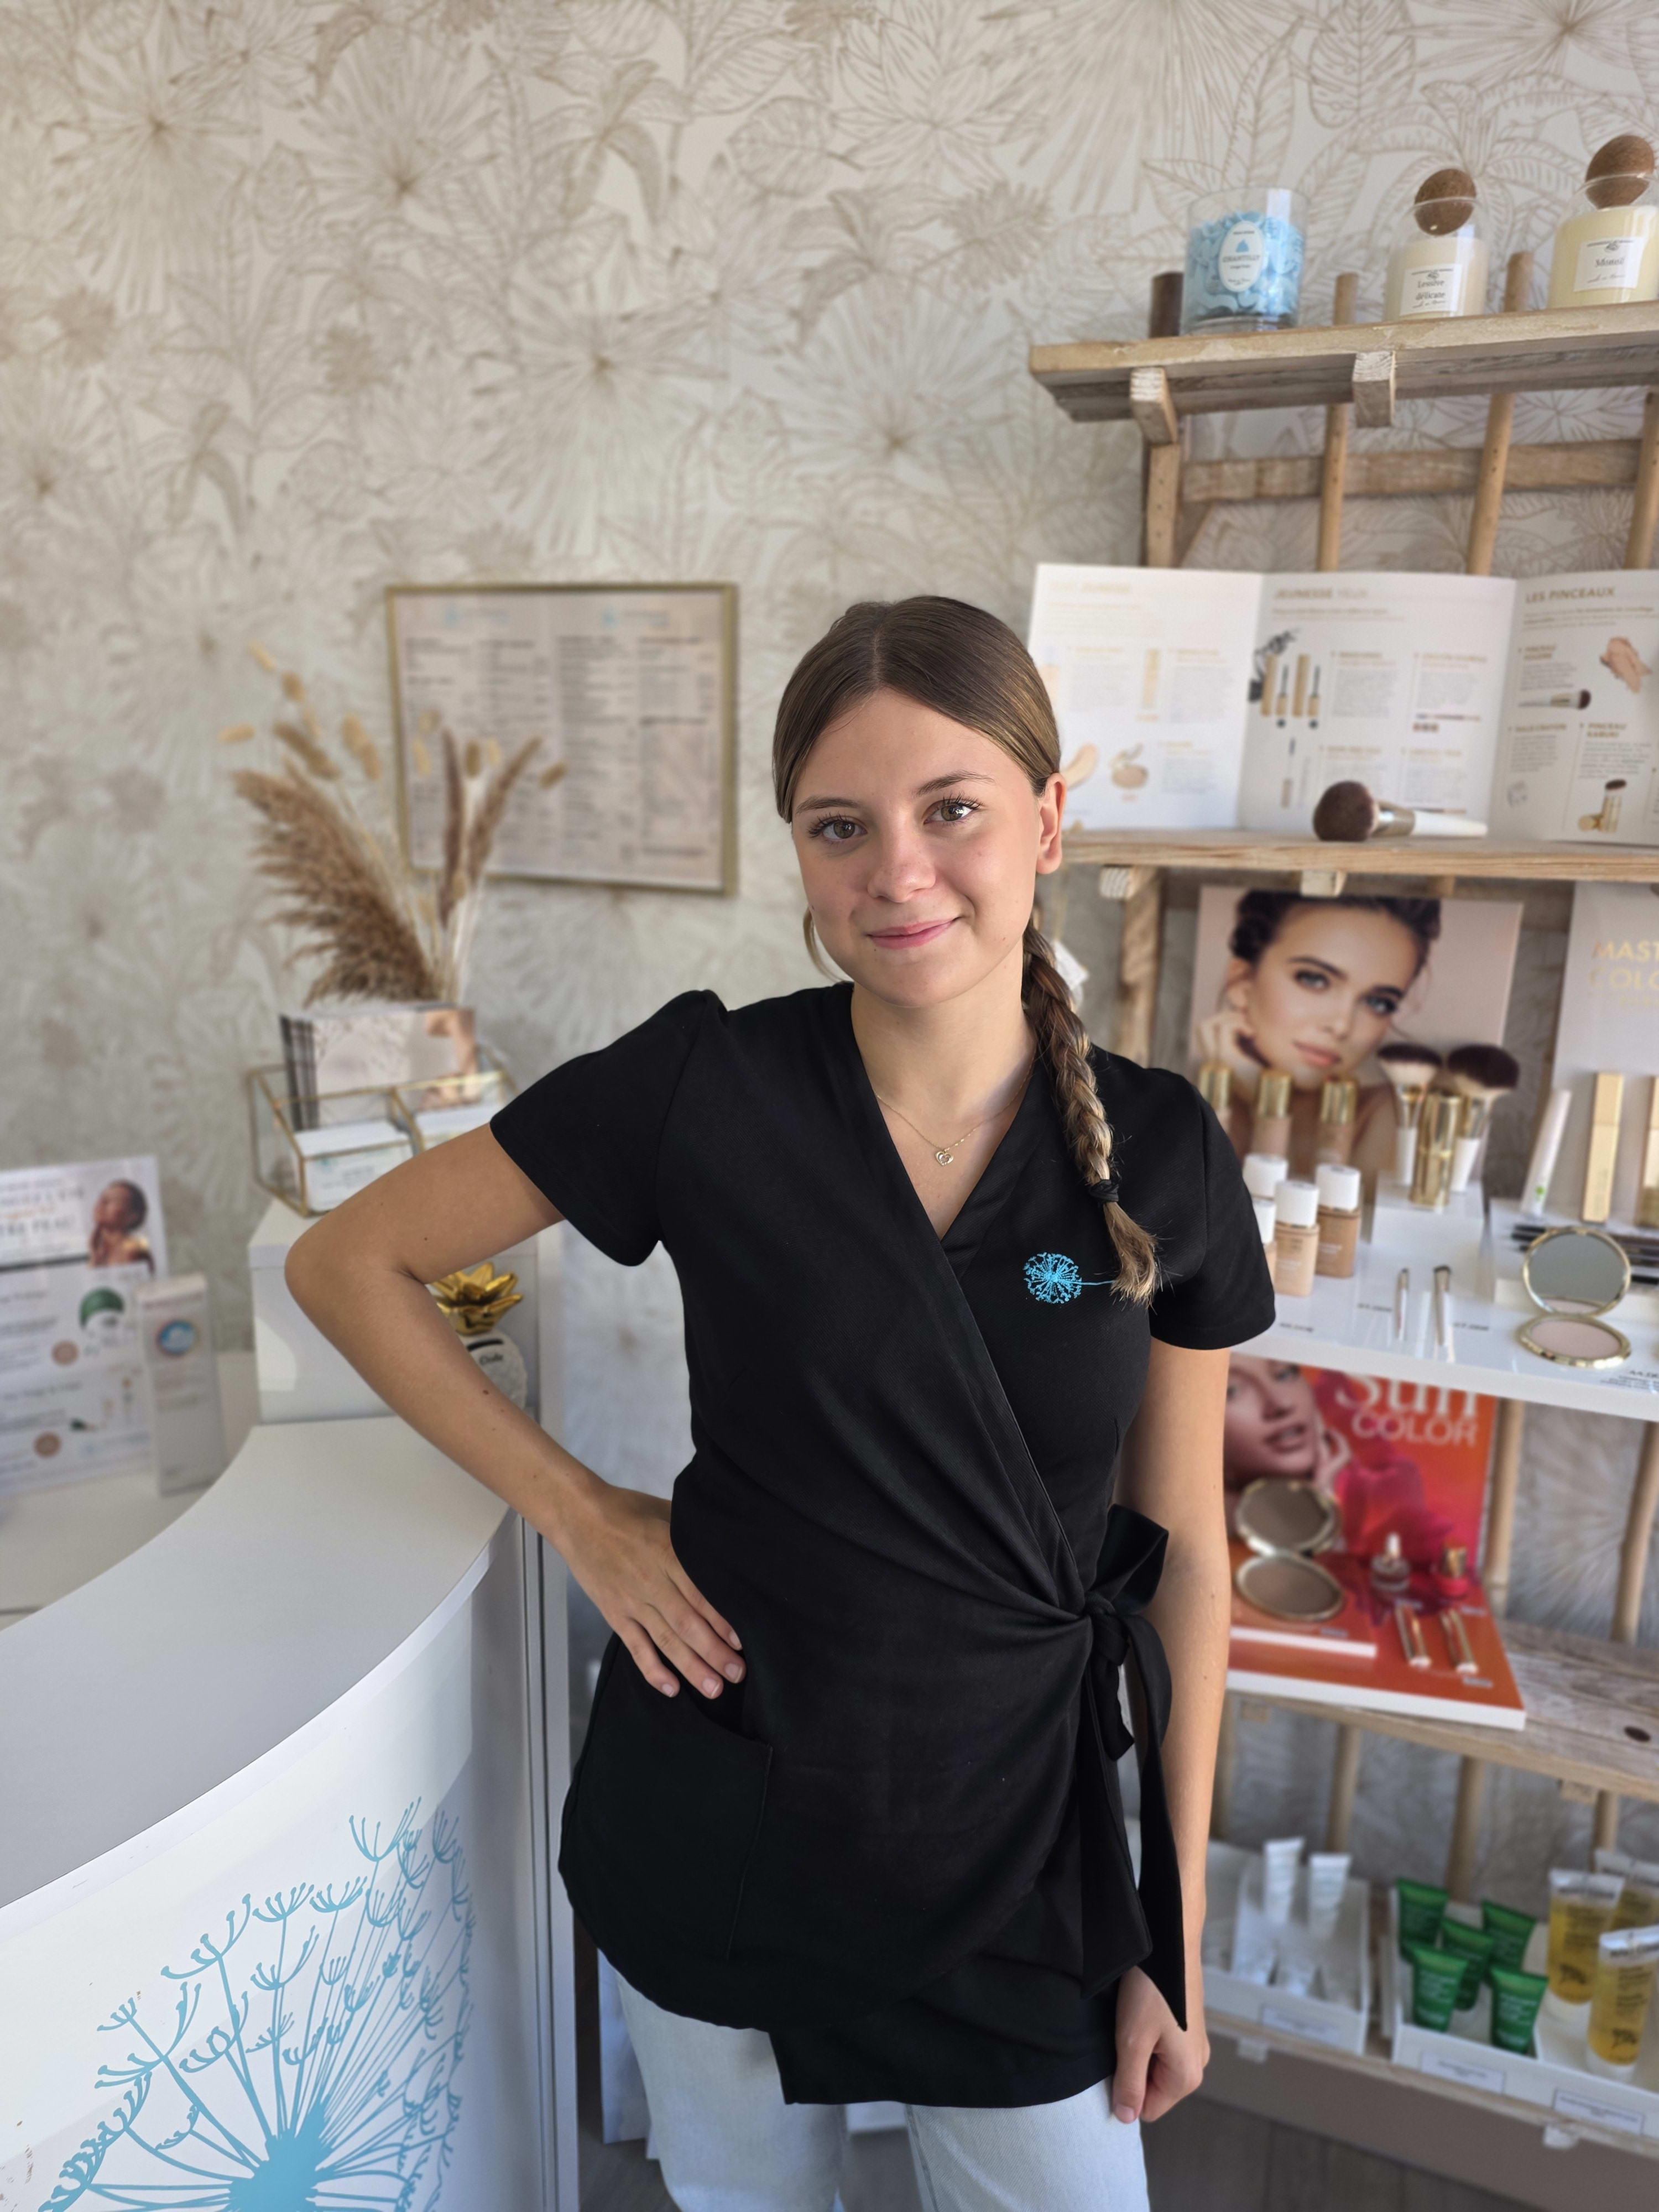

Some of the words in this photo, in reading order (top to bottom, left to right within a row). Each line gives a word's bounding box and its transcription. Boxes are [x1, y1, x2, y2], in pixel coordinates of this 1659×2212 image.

[1525, 590, 1546, 604] LES
[1549, 586, 1615, 600] PINCEAUX
[1352, 1410, 1478, 1447] COLOR
